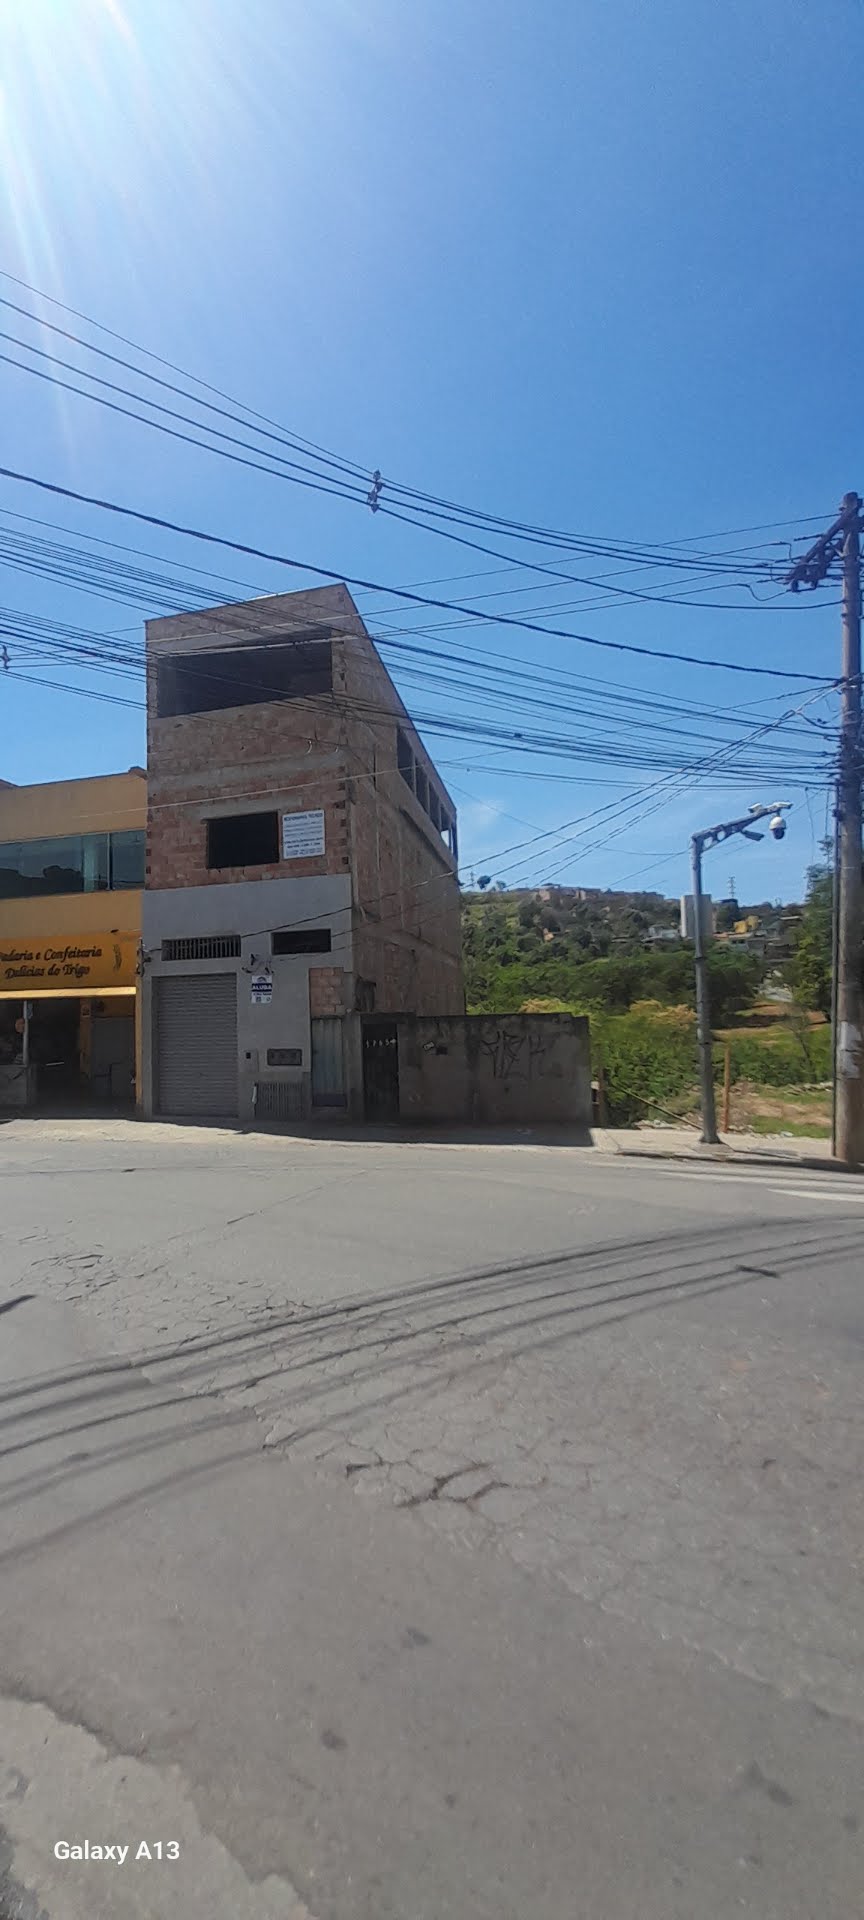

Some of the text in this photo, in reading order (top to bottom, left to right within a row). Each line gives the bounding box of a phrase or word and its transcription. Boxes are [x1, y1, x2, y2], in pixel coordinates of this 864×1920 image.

[36, 952, 41, 960] e
[44, 945, 103, 963] Confeitaria
[62, 963, 91, 978] Trigo
